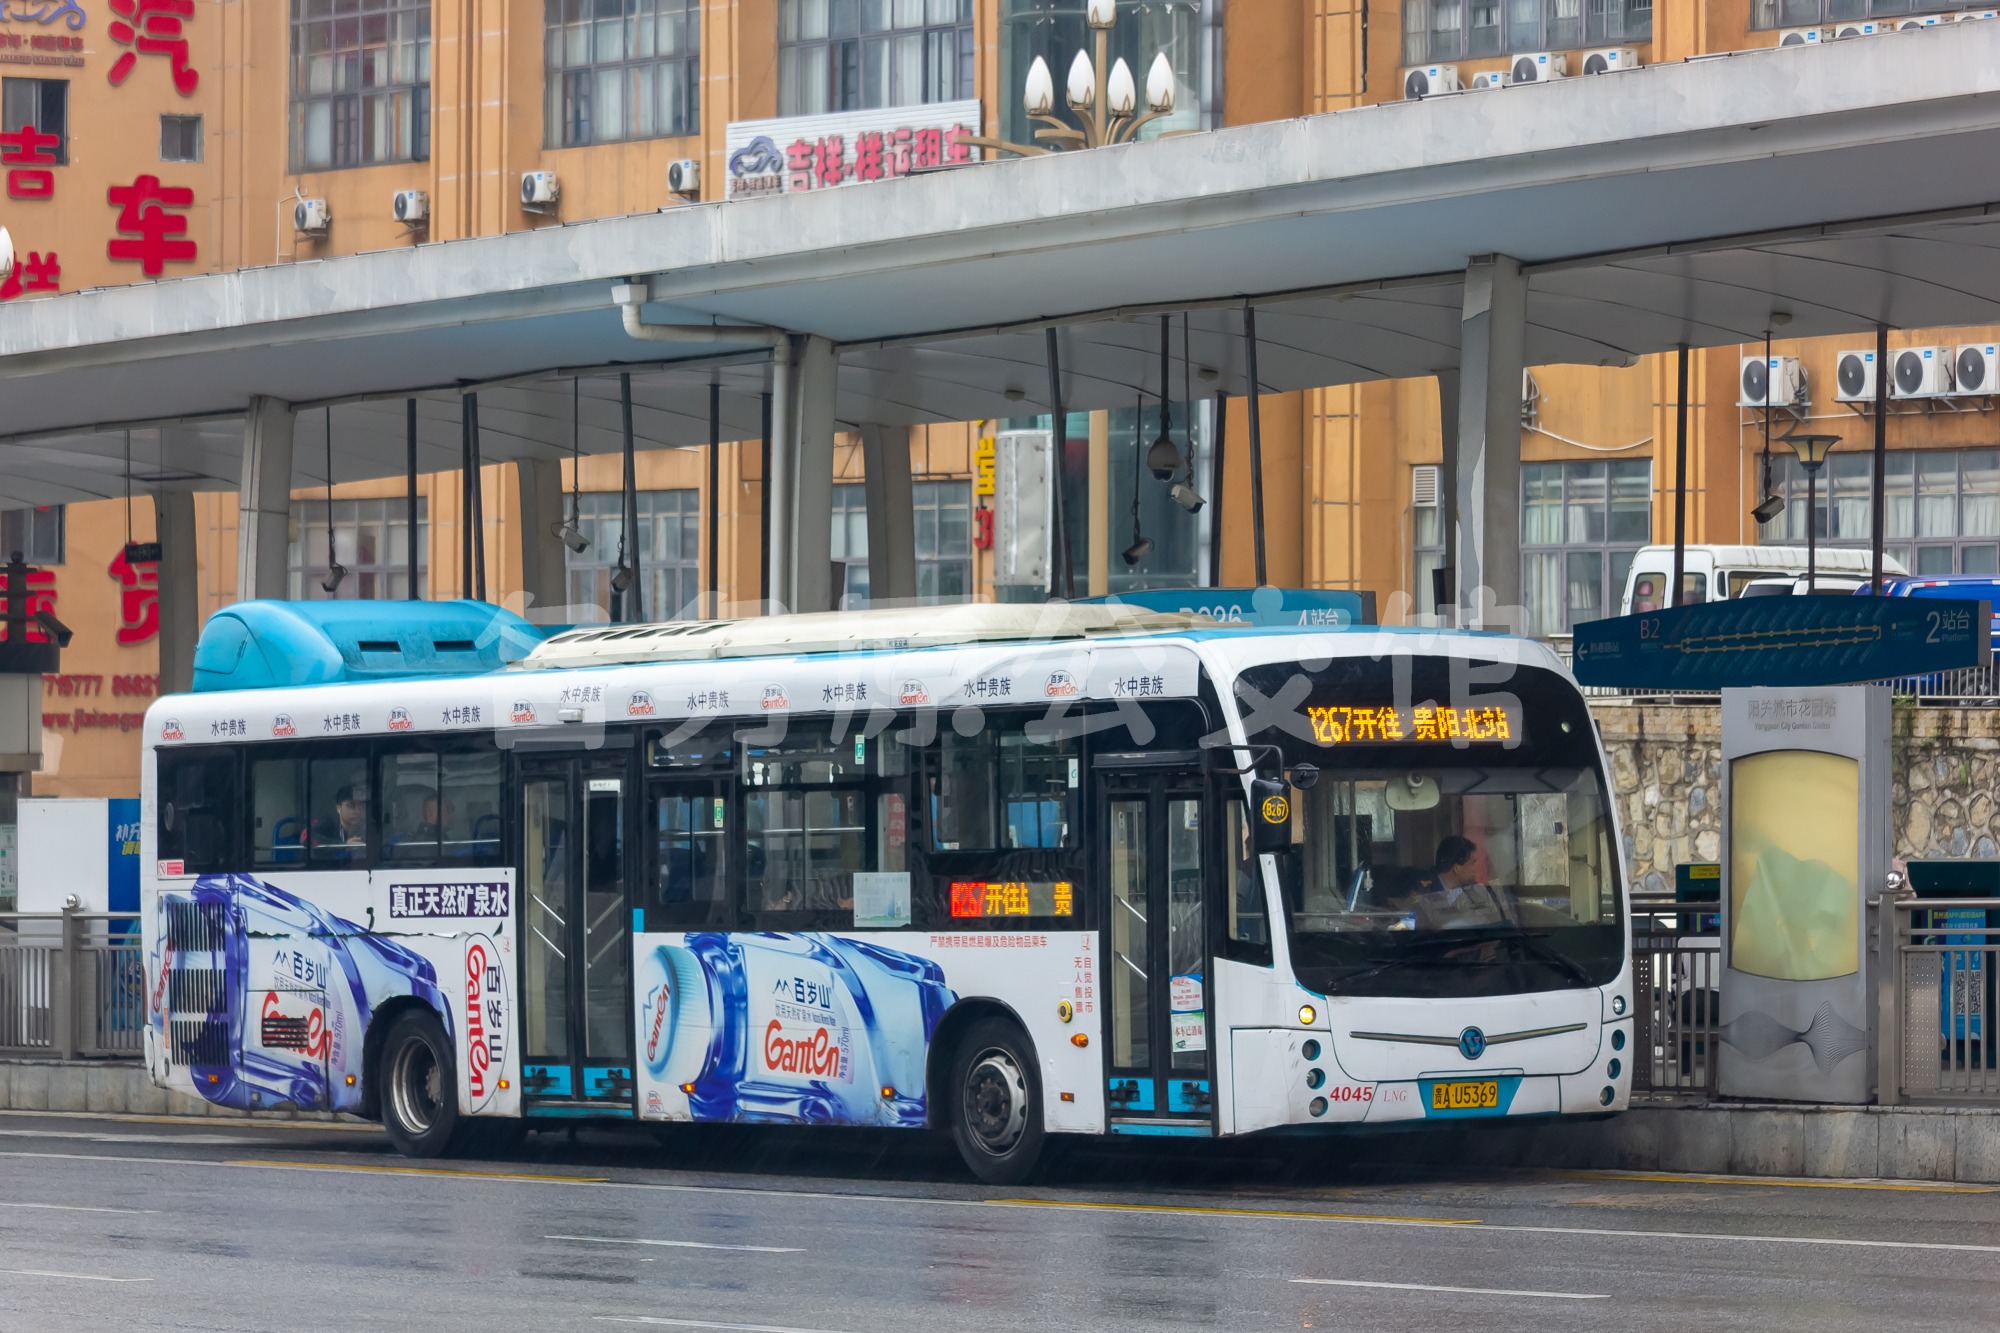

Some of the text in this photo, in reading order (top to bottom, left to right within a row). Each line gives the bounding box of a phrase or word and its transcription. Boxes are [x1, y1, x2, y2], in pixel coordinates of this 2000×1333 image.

[560, 686, 602, 703] 水中贵族
[822, 681, 867, 703] 水中贵族
[963, 677, 1012, 698] 水中贵族
[1114, 675, 1164, 697] 水中贵族
[687, 690, 730, 710] 水中贵族
[323, 713, 361, 731] 水中贵族
[442, 705, 481, 724] 水中贵族
[1412, 706, 1510, 741] 贵阳北站
[211, 719, 247, 737] 水中贵族
[1265, 805, 1285, 817] B267
[392, 885, 508, 917] 真正天然矿泉水
[1053, 881, 1073, 915] 贵
[930, 935, 1048, 948] 严禁携带易燃易爆及危险物品乘车
[293, 951, 327, 990] 百岁山
[794, 976, 831, 1010] 百岁山
[1073, 956, 1084, 1013] 无人售票
[1083, 956, 1093, 1013] 自觉投币
[487, 965, 503, 1063] 百岁山
[764, 1018, 840, 1078] Ganten
[1329, 1086, 1407, 1103] 4045 LNG
